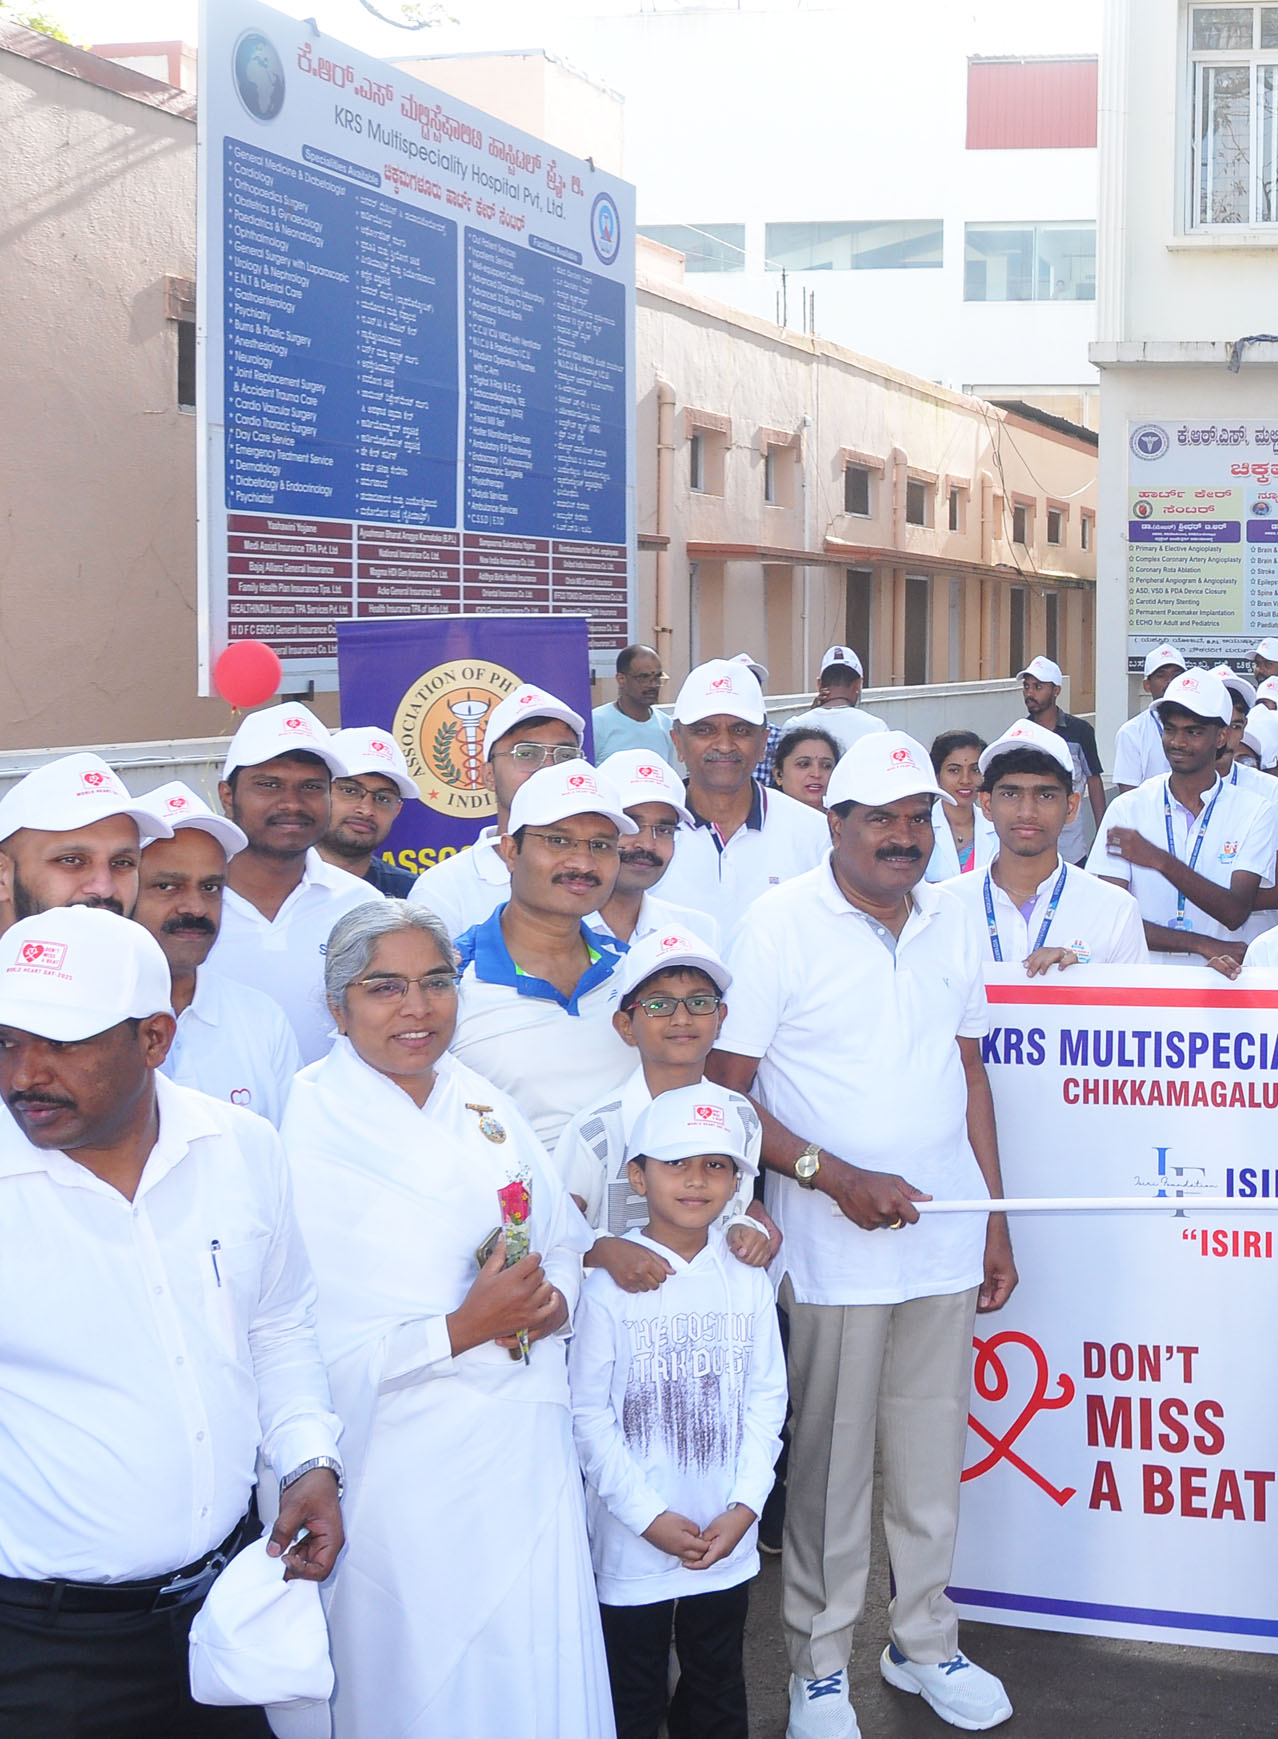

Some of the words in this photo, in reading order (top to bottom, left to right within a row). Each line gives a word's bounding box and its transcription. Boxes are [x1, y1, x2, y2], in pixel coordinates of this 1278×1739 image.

[335, 104, 362, 134] KRS
[368, 118, 468, 181] Multispeciality
[472, 165, 519, 201] Hospital
[547, 197, 566, 220] Ltd.
[234, 163, 273, 186] Cardiology
[284, 195, 308, 213] Surgery
[234, 257, 262, 274] Urology
[235, 303, 271, 323] Psychiatry
[263, 325, 284, 340] Plastic
[286, 331, 311, 347] Surgery
[235, 351, 273, 369] Neurology
[235, 366, 252, 379] Joint
[254, 370, 299, 389] Replacement
[301, 379, 326, 395] Surgery
[235, 429, 251, 442] Day
[253, 431, 270, 443] Care
[272, 434, 295, 446] Service
[235, 444, 276, 460] Emergency
[278, 449, 309, 463] Treatment
[310, 454, 334, 466] Service
[235, 459, 281, 476] Dermatology
[1190, 556, 1206, 564] Artery
[1208, 556, 1241, 564] Angioplasty
[401, 670, 457, 778] ASSOCIATION
[461, 667, 486, 681] OF
[447, 792, 497, 809] INDI
[983, 1027, 1046, 1066] KRS
[1086, 1394, 1225, 1455] MISS
[1089, 1460, 1122, 1512] A
[1142, 1464, 1275, 1522] BEAT
